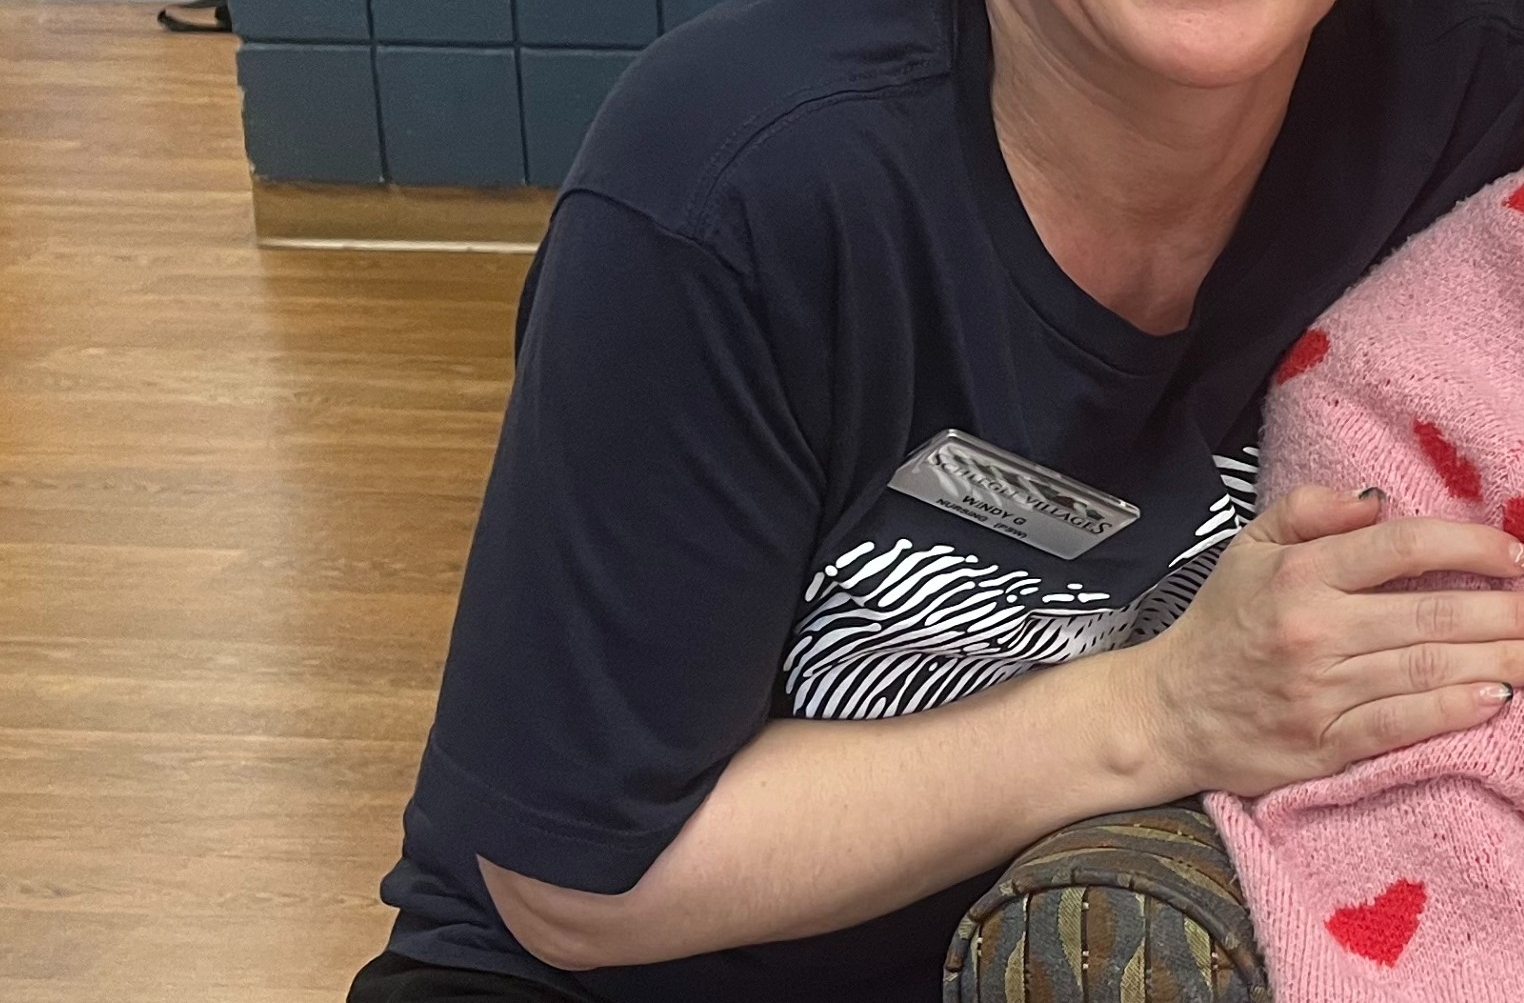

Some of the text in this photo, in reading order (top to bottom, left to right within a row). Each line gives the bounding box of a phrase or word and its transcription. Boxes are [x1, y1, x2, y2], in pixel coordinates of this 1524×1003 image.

[936, 498, 988, 522] NURSING
[962, 495, 1027, 526] WINDY G
[1025, 496, 1112, 535] VILLAGES
